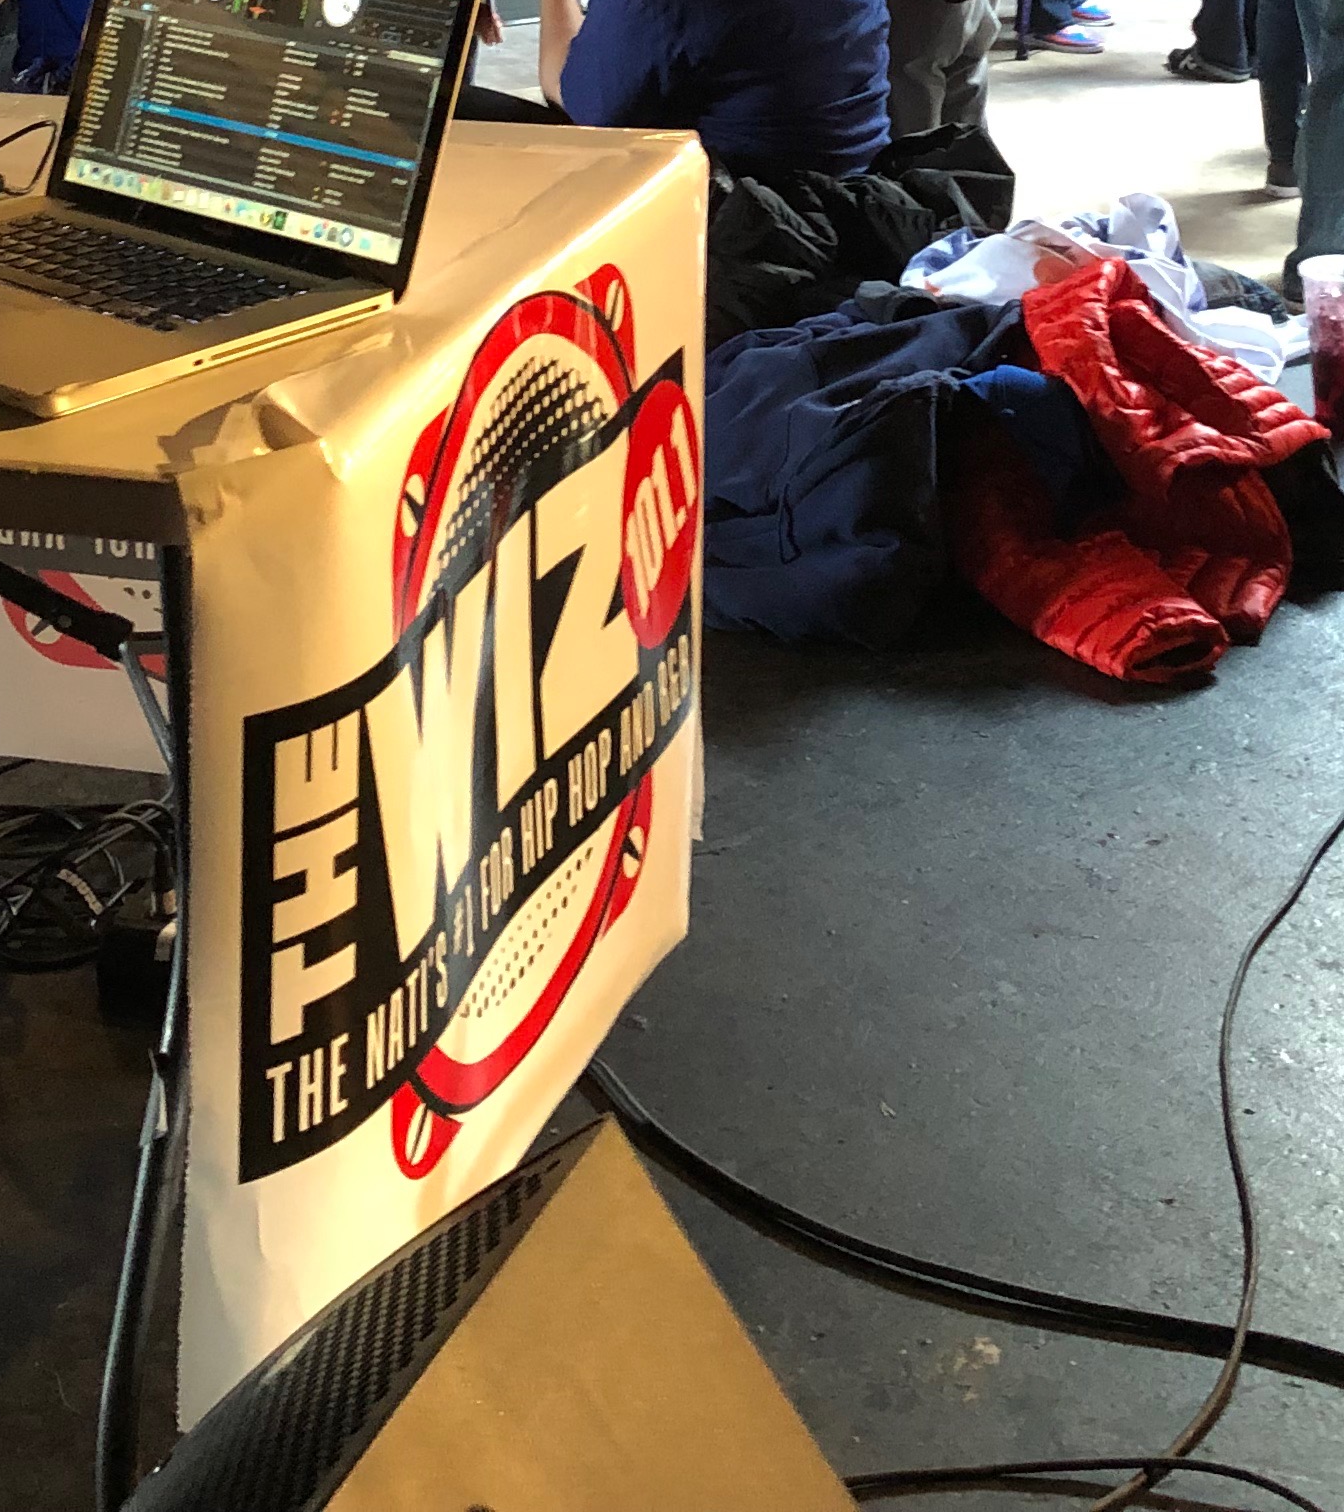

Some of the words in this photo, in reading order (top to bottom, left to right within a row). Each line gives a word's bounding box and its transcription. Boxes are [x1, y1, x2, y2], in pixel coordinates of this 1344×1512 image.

[265, 1031, 350, 1144] THE
[364, 930, 449, 1090] NATI'S
[452, 884, 475, 957] #1
[479, 826, 515, 932] FOR
[520, 777, 559, 876] HIP
[567, 727, 613, 828] HOP
[619, 680, 656, 778] AND
[270, 708, 360, 1046] THE
[362, 426, 641, 963] WIZ
